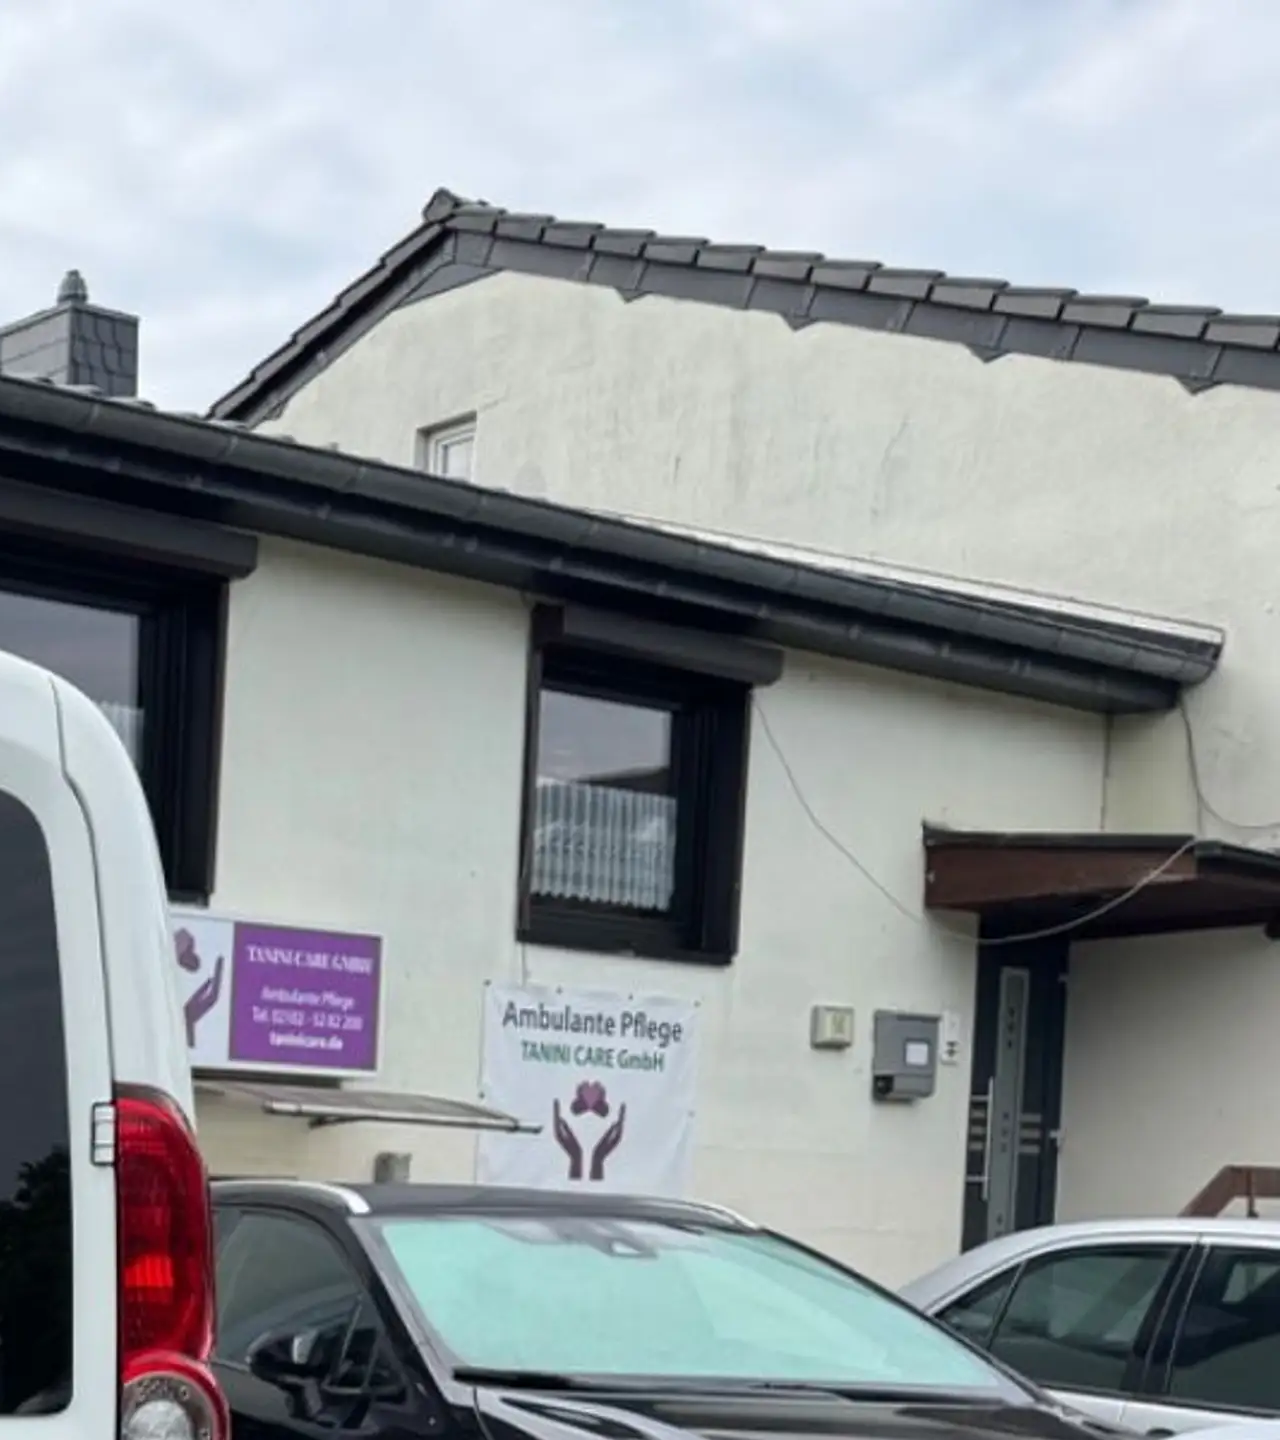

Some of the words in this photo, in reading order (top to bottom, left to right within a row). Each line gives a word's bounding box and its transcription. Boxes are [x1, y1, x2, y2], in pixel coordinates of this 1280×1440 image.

[502, 1001, 617, 1037] Ambulante
[620, 1010, 683, 1049] Pflege
[520, 1040, 571, 1065] TANINI
[573, 1045, 615, 1069] CARE
[616, 1048, 666, 1073] GmbH
